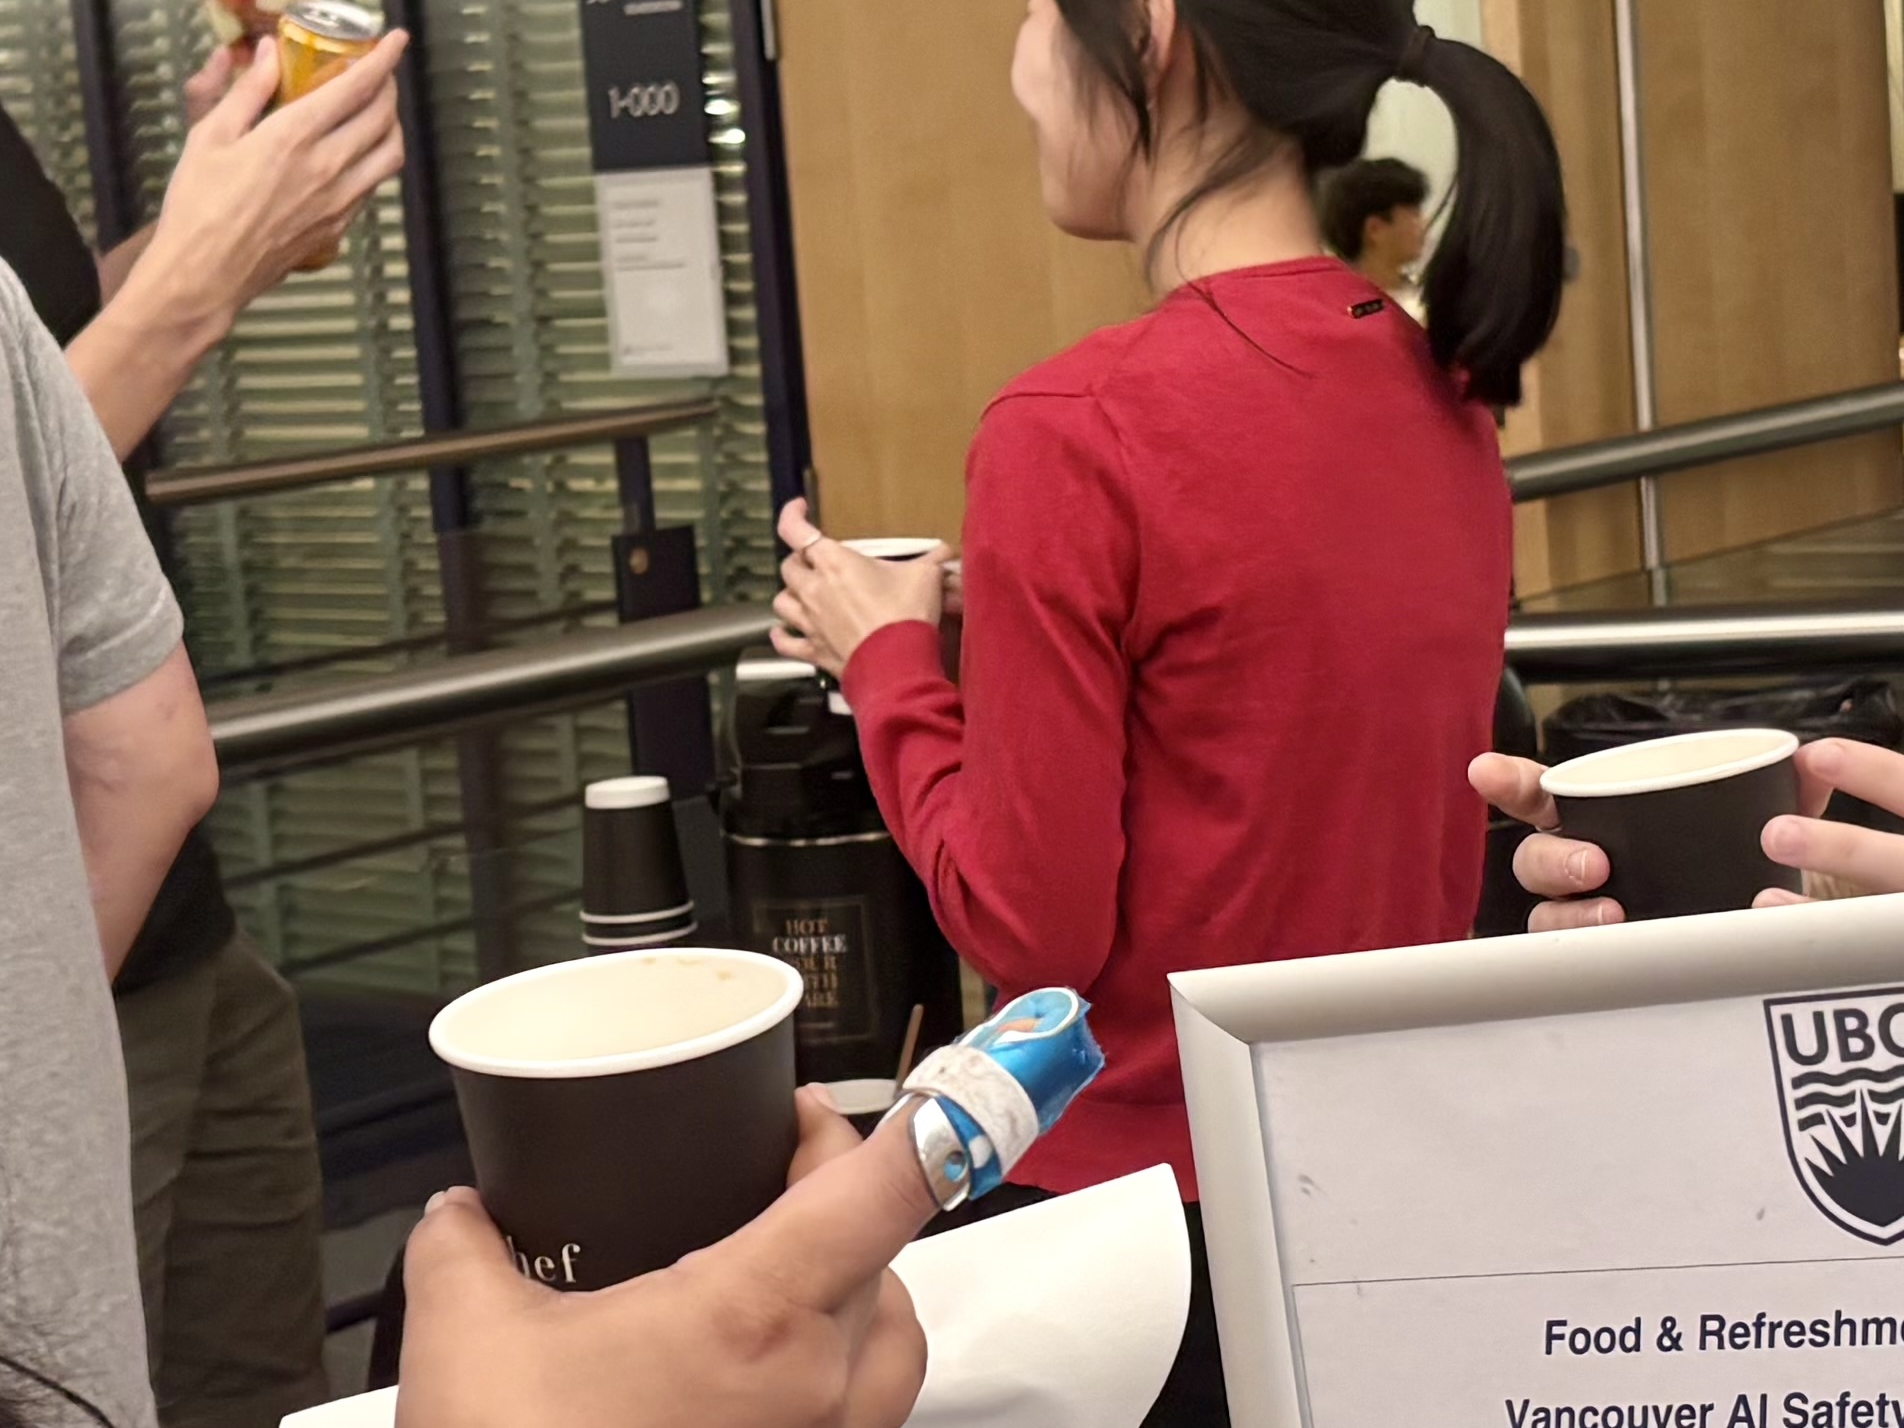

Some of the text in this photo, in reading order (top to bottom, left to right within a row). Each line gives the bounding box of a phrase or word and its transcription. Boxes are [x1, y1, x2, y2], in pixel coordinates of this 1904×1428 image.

[785, 919, 829, 934] HOT
[772, 934, 847, 953] COFFEE
[1544, 1315, 1642, 1355] Food
[1655, 1315, 1685, 1353] &
